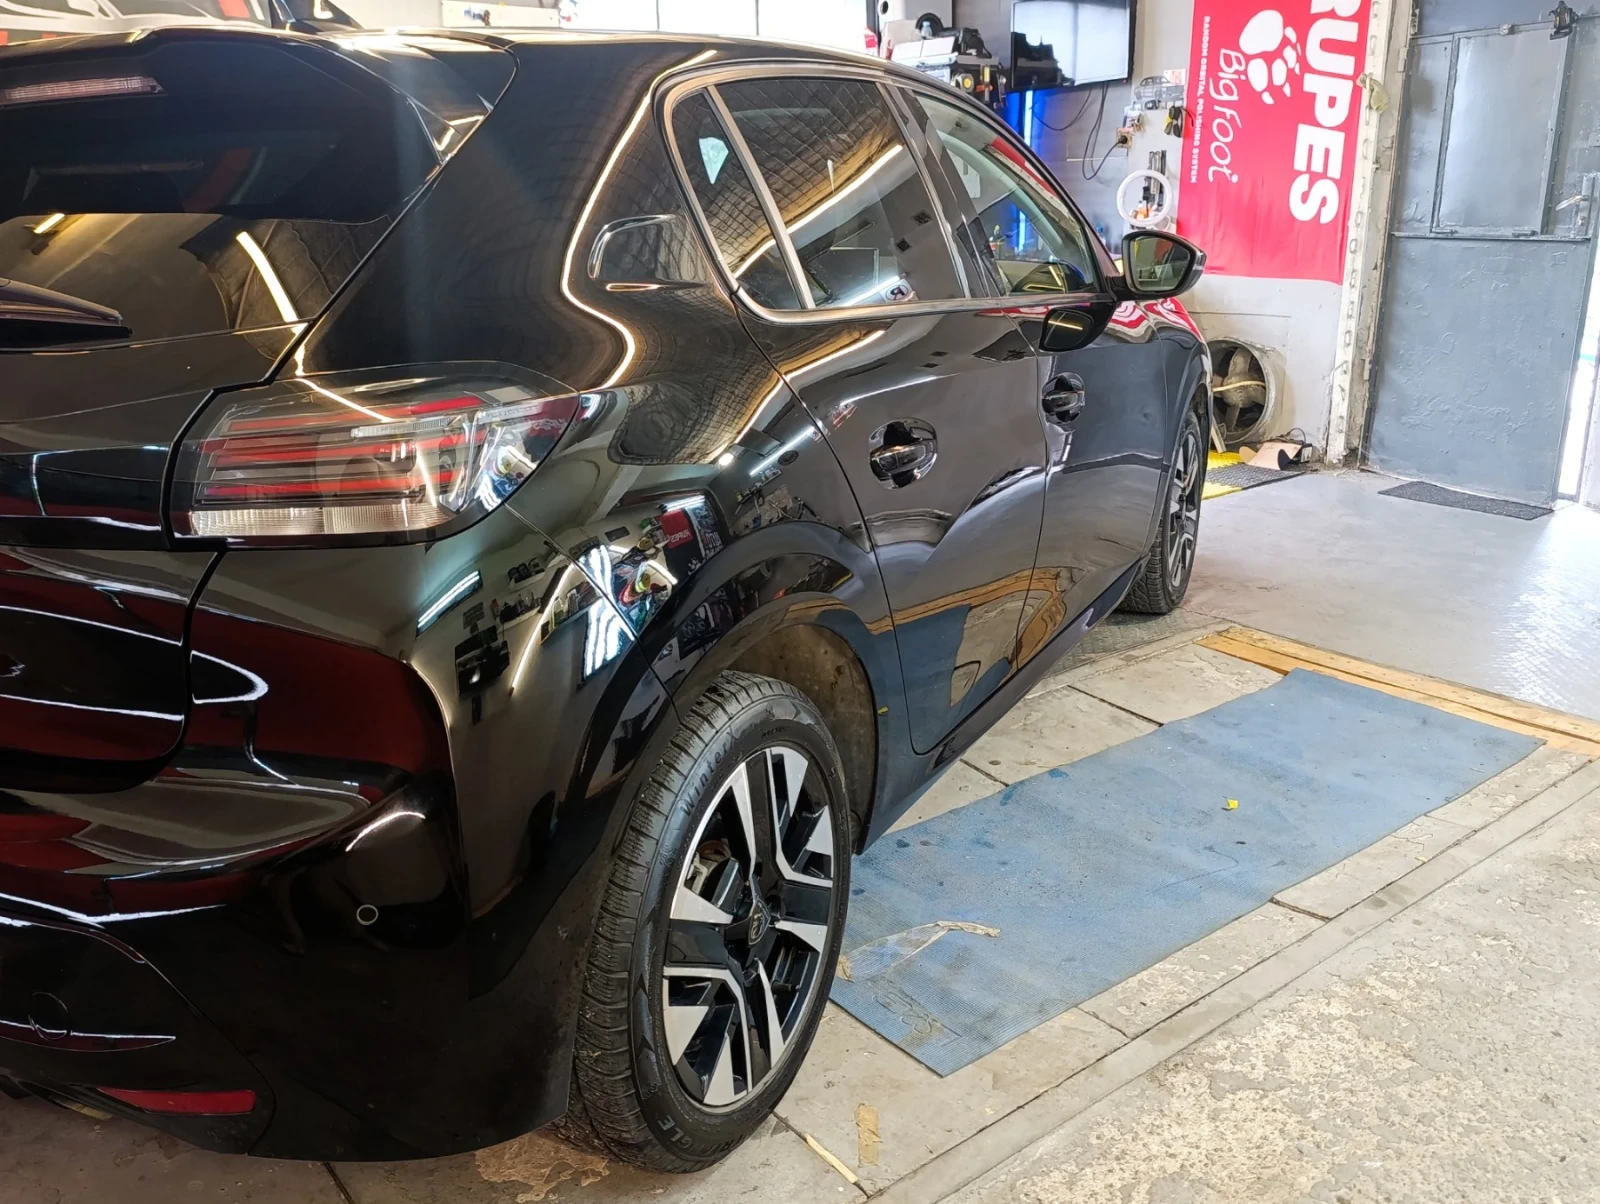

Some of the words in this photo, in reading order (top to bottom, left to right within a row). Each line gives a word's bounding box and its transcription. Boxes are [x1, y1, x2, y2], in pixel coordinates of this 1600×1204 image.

[1201, 16, 1211, 57] RANDOM
[1197, 58, 1207, 97] ORBITAL
[1193, 98, 1204, 147] POLISHING
[1190, 148, 1200, 183] SYSTEM
